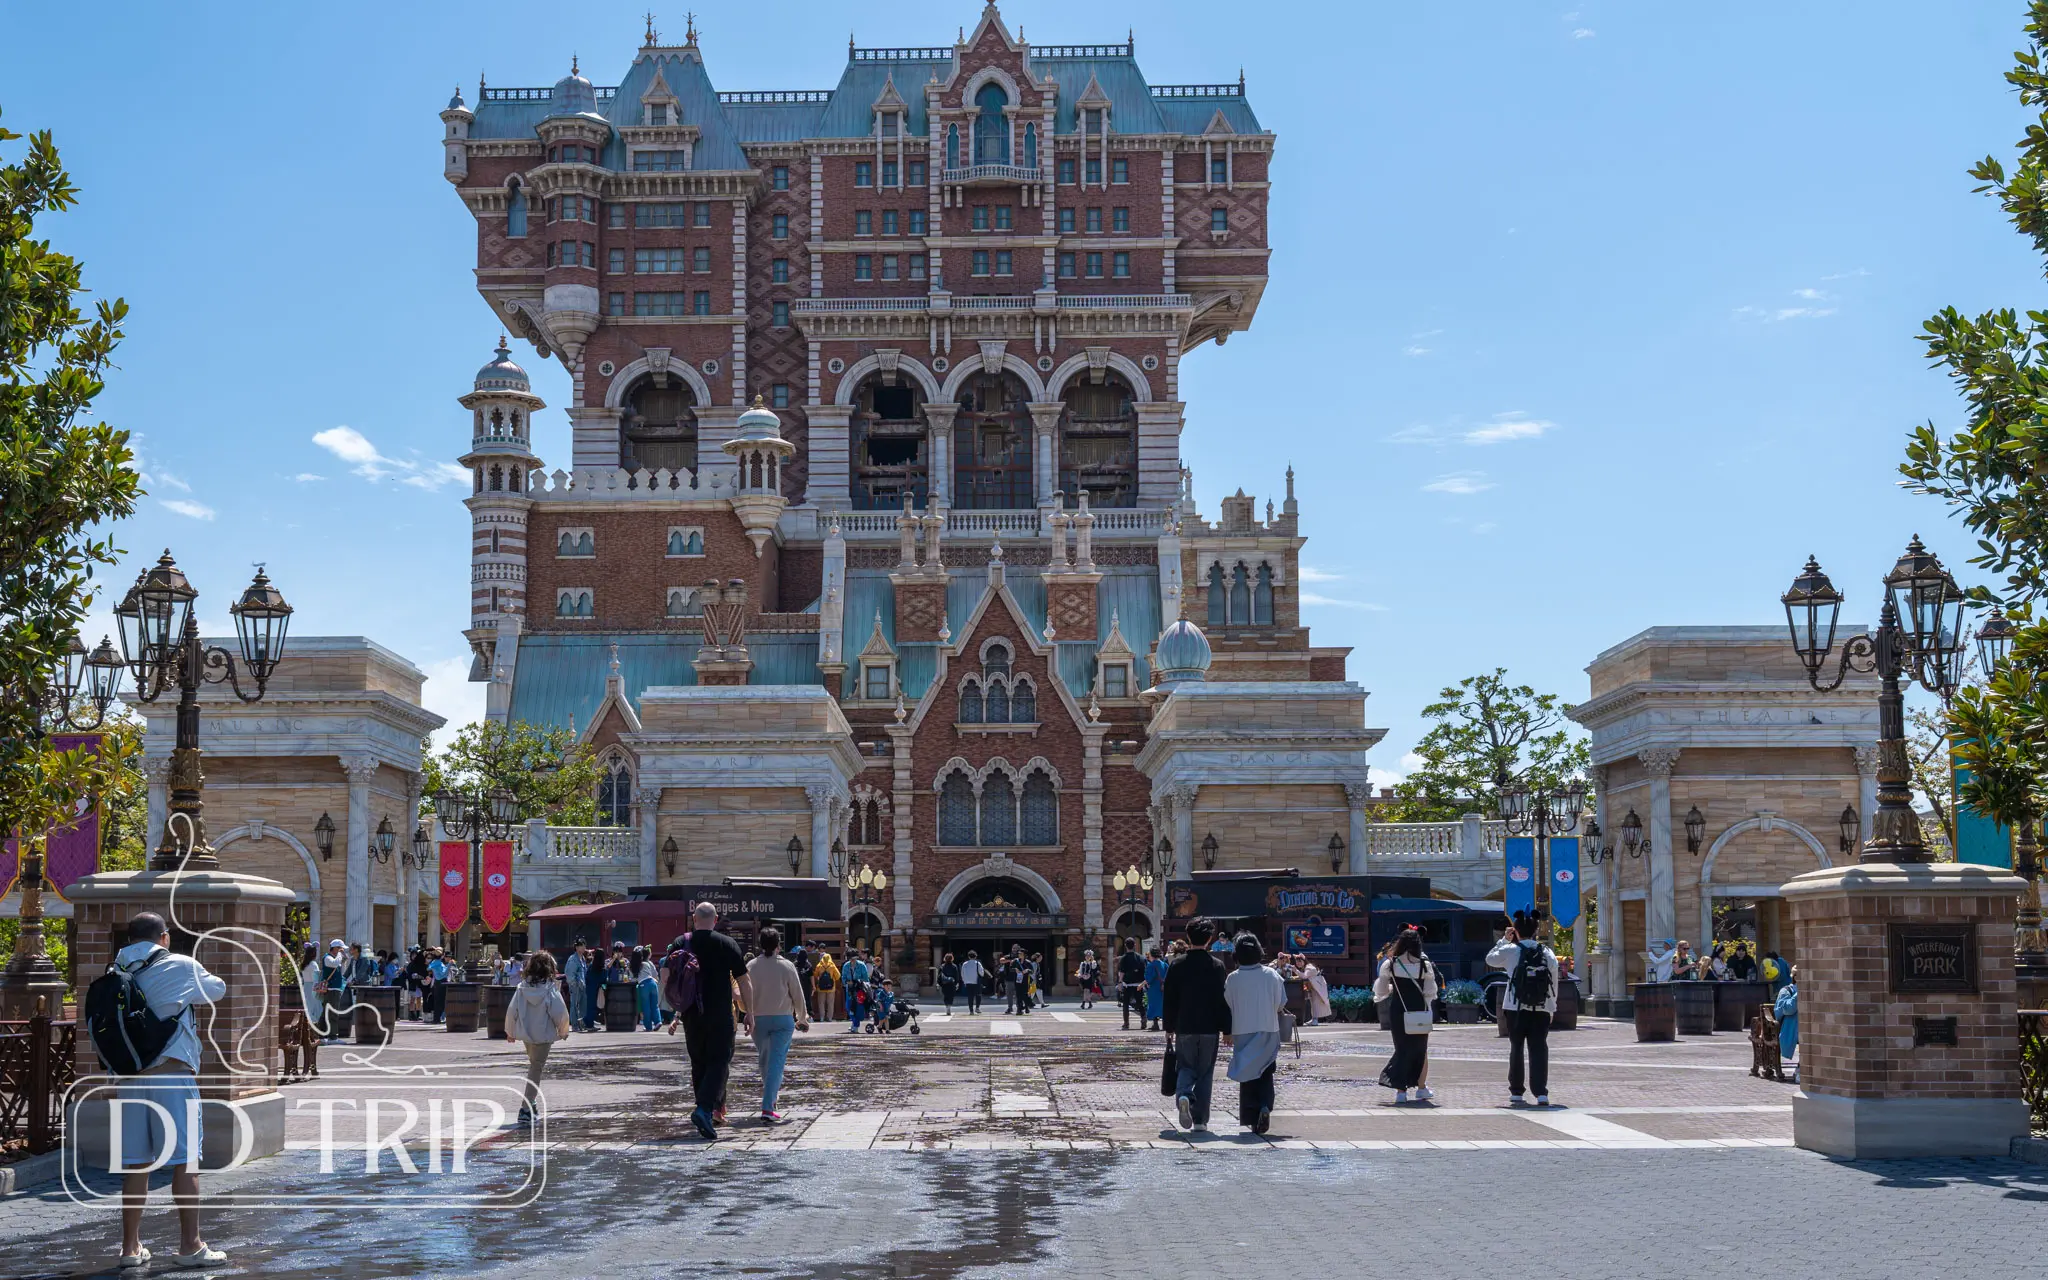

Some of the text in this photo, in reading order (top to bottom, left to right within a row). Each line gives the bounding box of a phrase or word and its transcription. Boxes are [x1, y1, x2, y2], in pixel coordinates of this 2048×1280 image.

[1694, 710, 1836, 722] THEATRE
[209, 719, 303, 731] MUSIC
[713, 756, 756, 766] ART
[1229, 752, 1312, 764] DANCE
[689, 900, 774, 915] Brages & More
[1907, 942, 1961, 957] WATERFRONT
[1912, 957, 1957, 975] PARK
